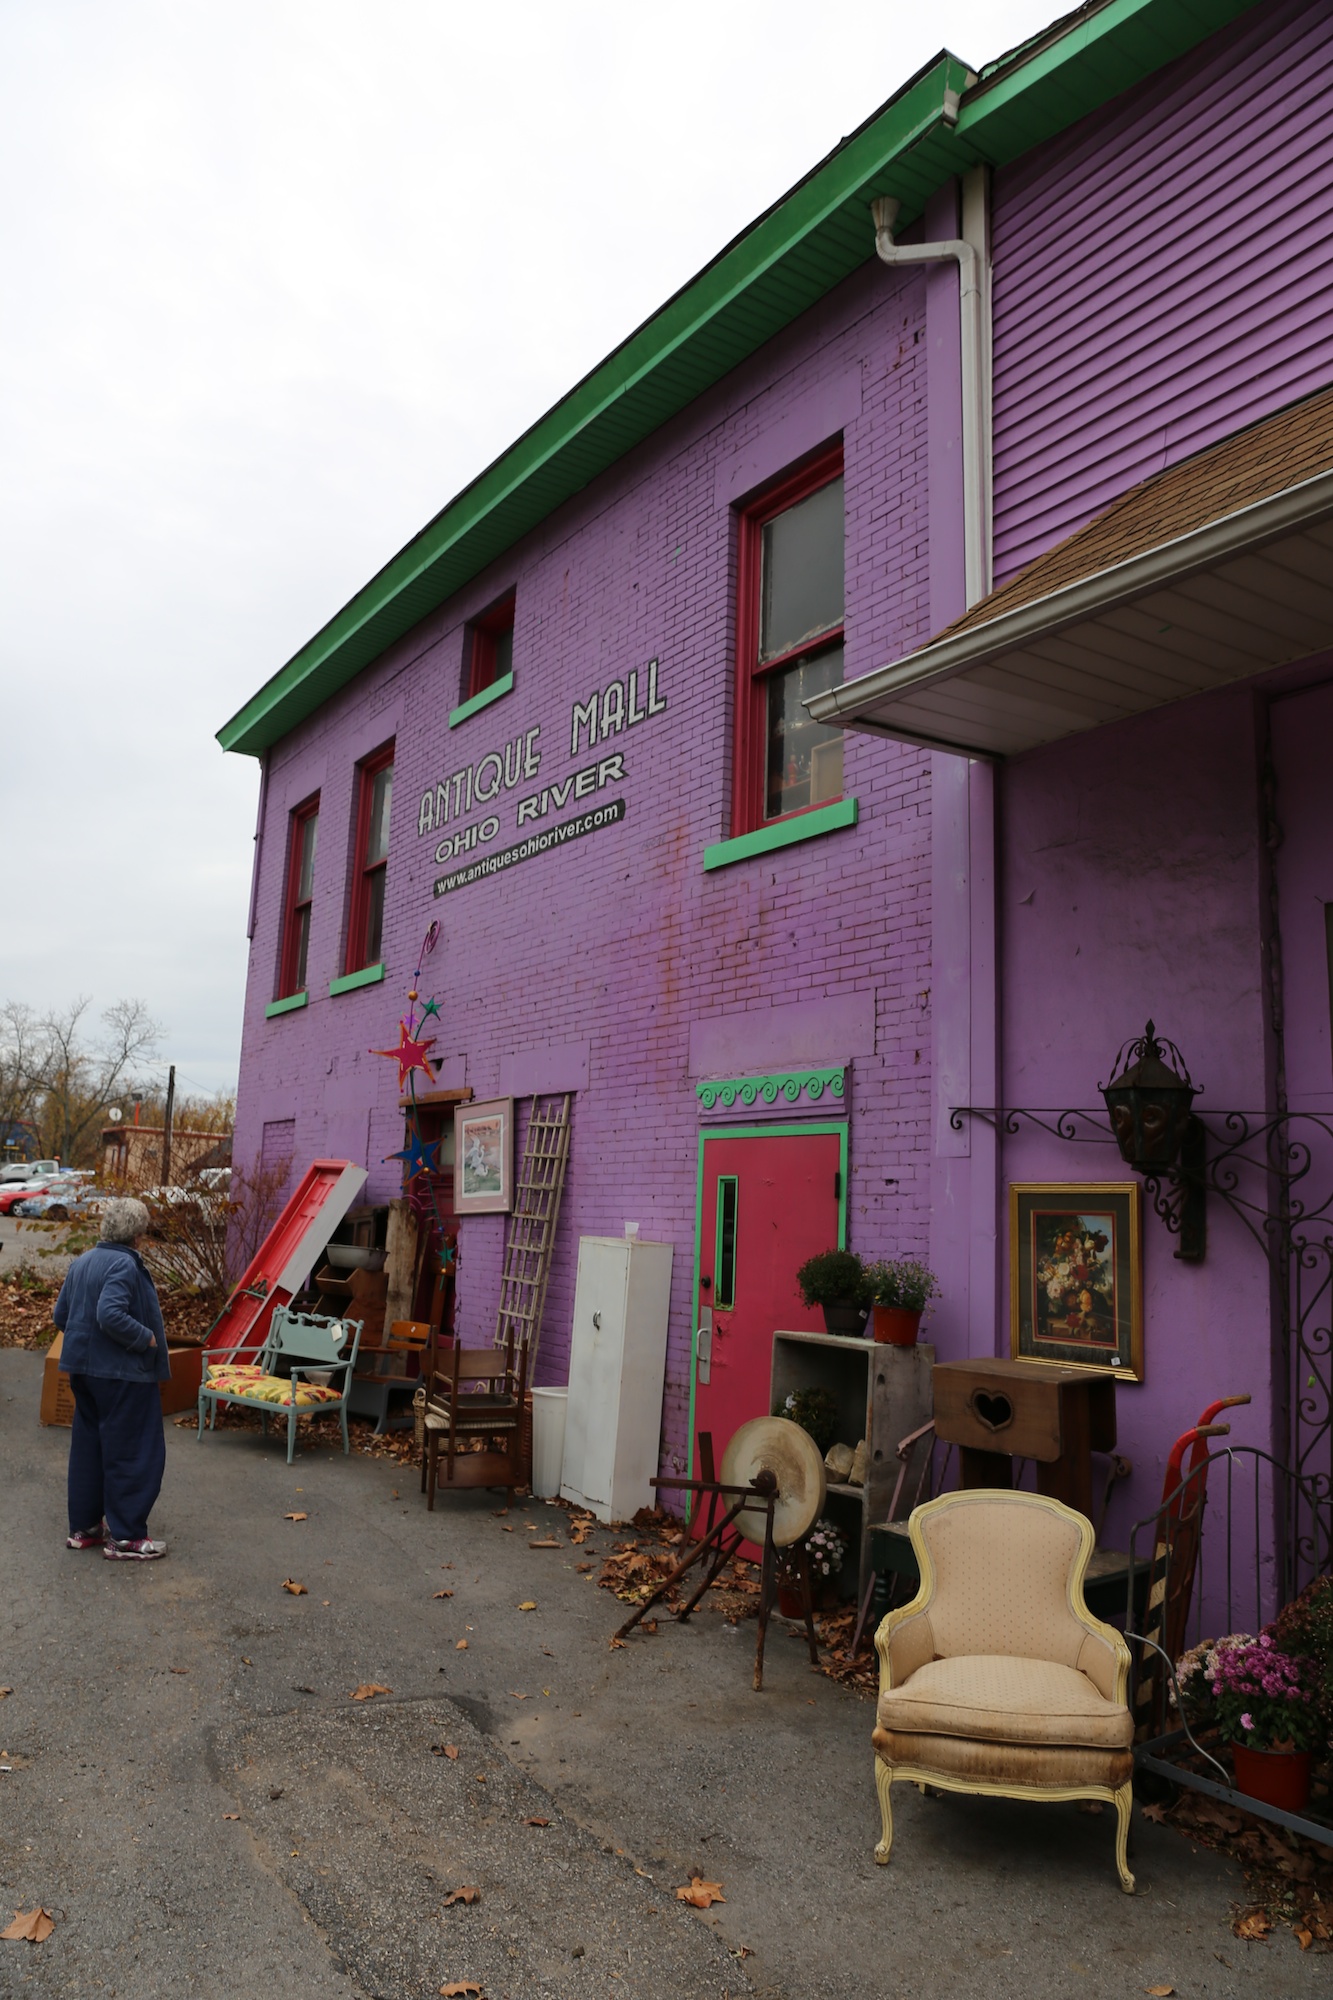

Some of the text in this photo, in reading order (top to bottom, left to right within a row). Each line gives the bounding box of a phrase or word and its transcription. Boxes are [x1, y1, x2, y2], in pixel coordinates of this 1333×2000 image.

[418, 657, 667, 839] ANTIQUE MALL
[435, 752, 629, 864] OHIO RIVER
[437, 803, 619, 894] www.antiquesohioriver.com
